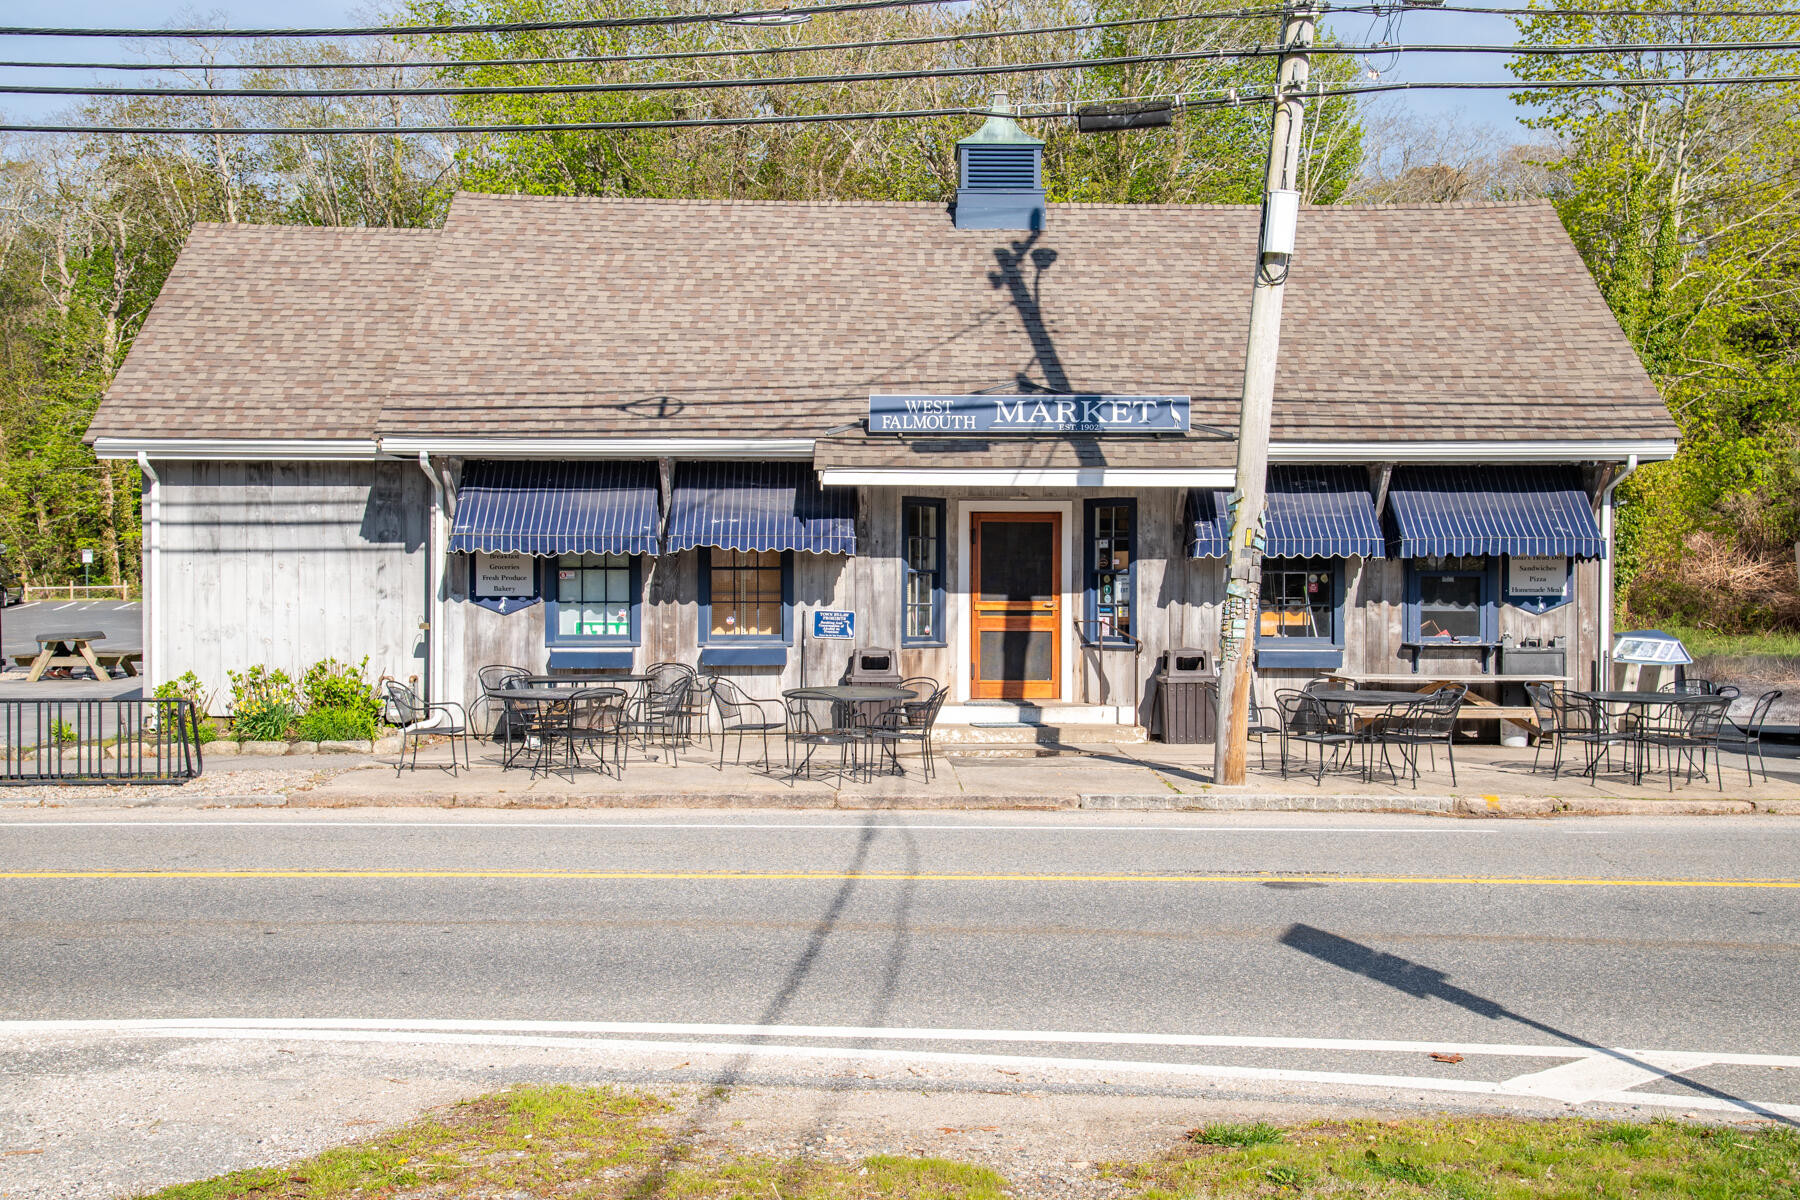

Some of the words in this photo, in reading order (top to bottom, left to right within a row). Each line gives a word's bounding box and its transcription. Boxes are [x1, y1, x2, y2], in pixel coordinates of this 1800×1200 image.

[904, 399, 954, 414] WEST
[993, 399, 1158, 424] MARKET
[881, 415, 977, 430] FALMOUTH
[1058, 423, 1078, 431] EST.
[1080, 423, 1099, 431] 1902
[493, 585, 515, 593] Bakery
